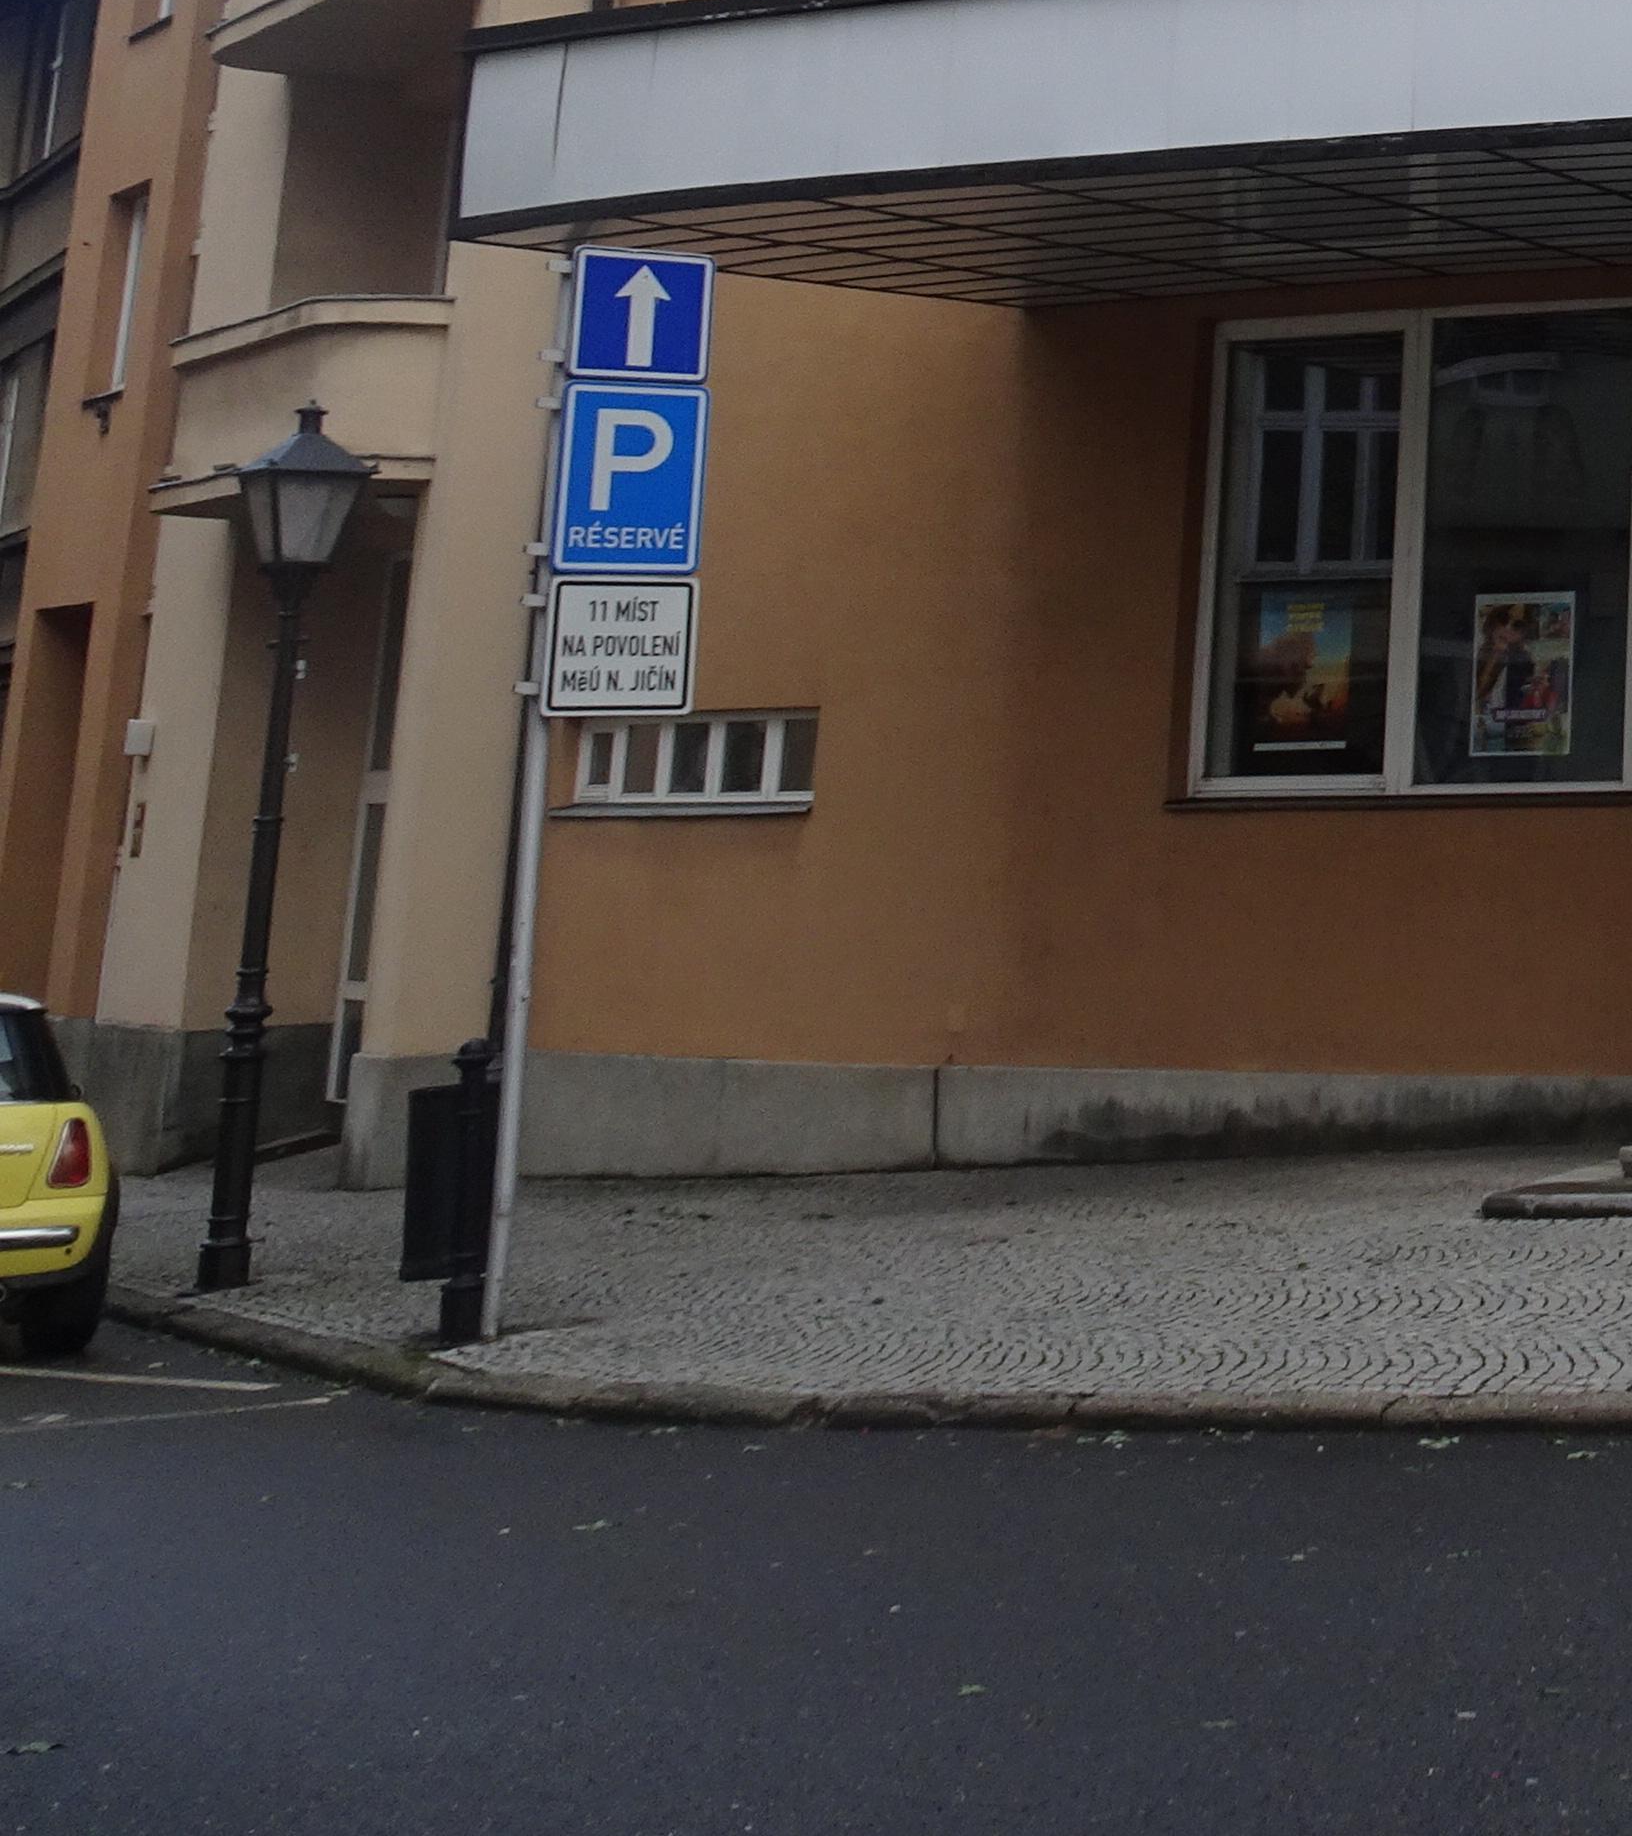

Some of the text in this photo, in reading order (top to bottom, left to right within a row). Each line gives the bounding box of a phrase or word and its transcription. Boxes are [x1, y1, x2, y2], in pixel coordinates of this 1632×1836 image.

[589, 408, 674, 511] P
[568, 521, 686, 550] RÉSERVÉ
[588, 595, 660, 623] 11 MÍST
[561, 629, 682, 659] NA POVOLENÍ
[560, 664, 677, 693] MěÚ N. JIČÍN
